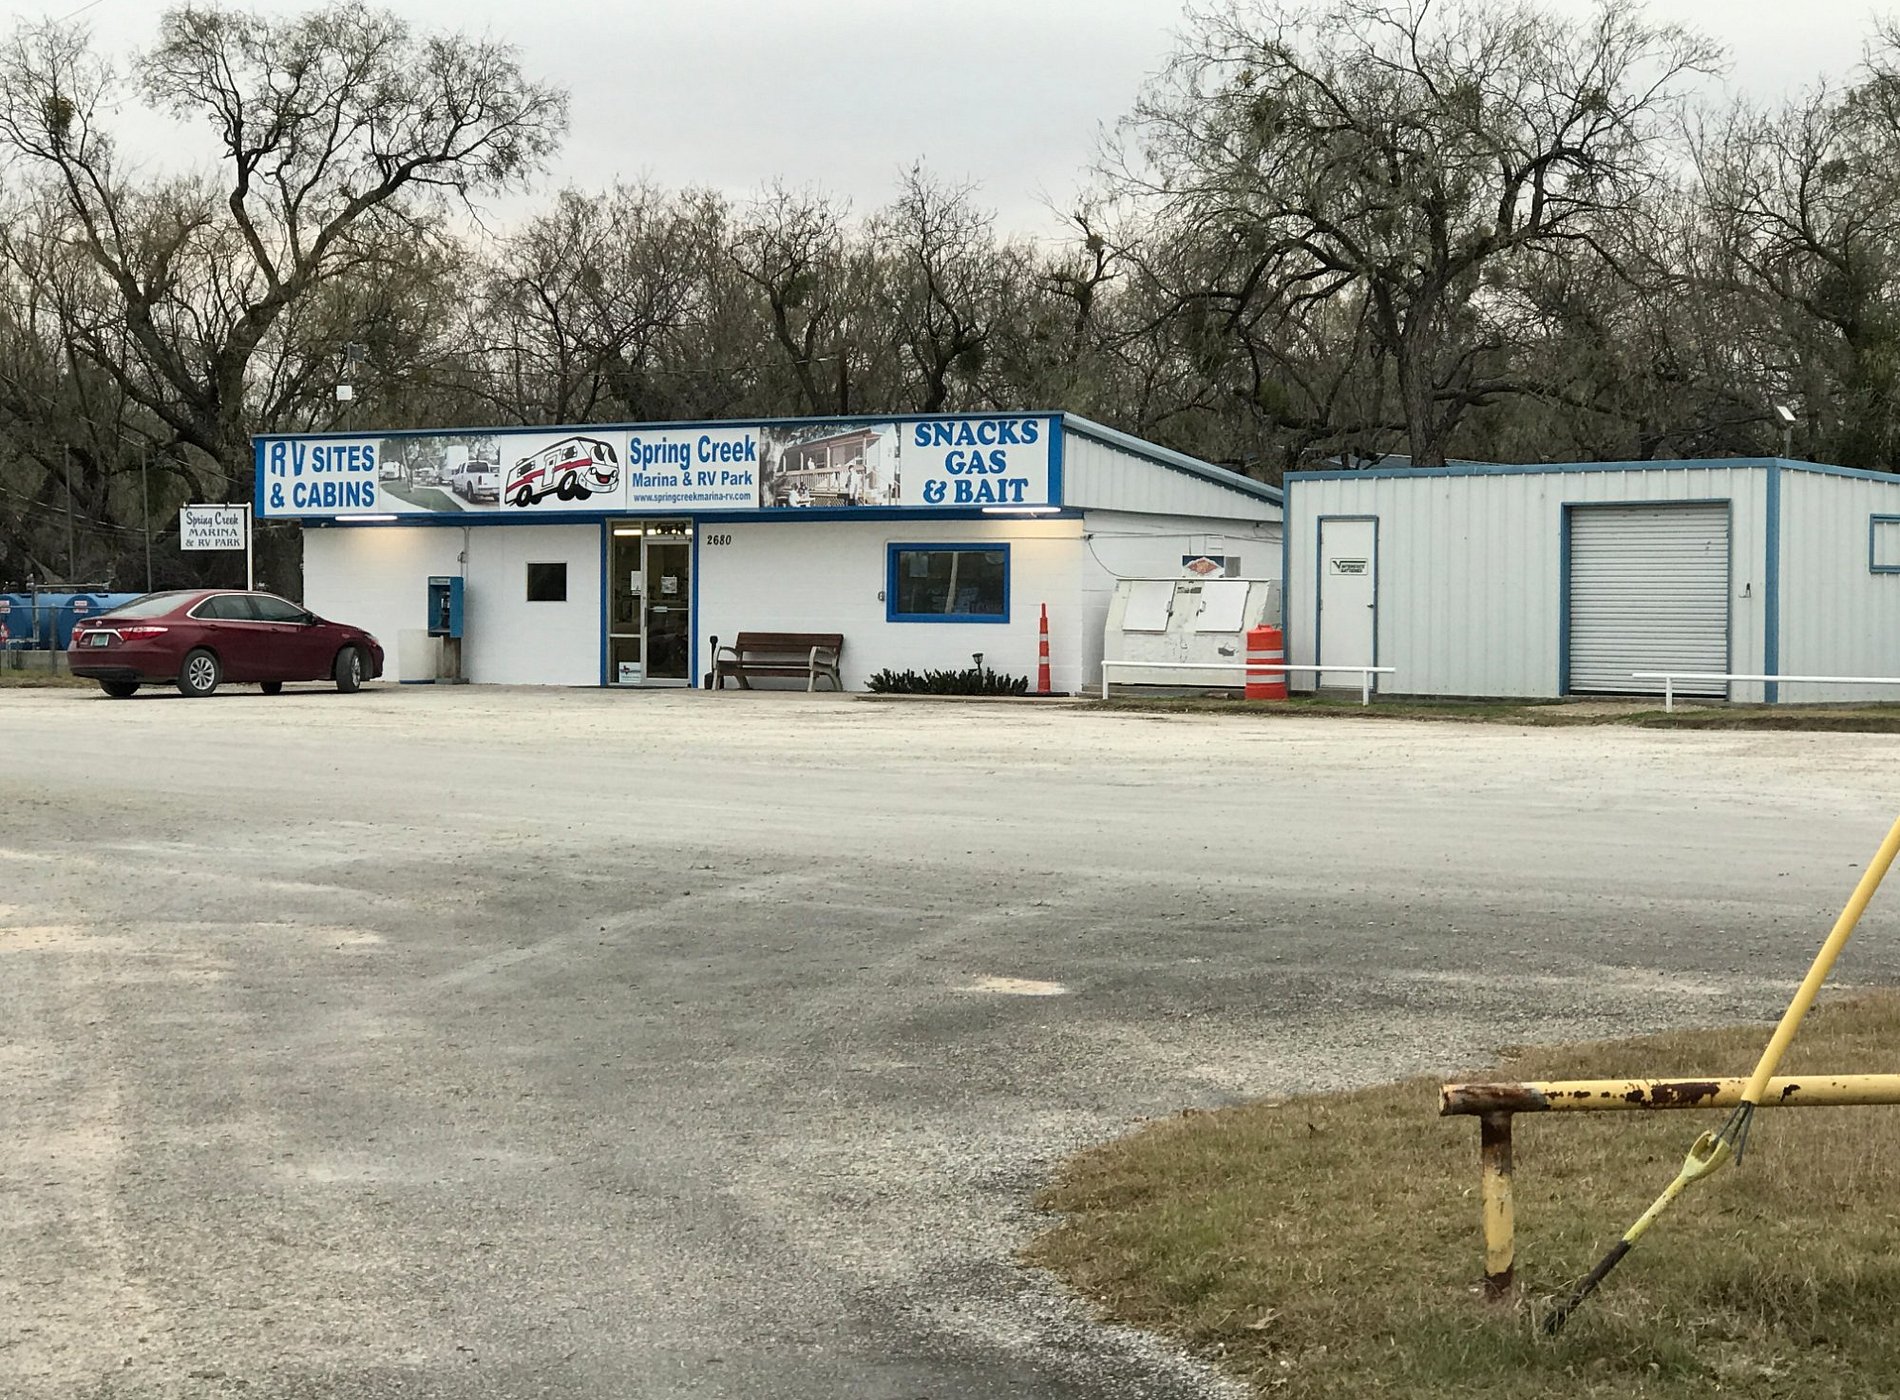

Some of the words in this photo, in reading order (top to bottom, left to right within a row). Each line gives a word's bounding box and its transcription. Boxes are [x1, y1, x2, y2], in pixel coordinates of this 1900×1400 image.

[914, 420, 1038, 446] SNACKS
[271, 441, 306, 477] RV
[312, 445, 374, 472] SITES
[630, 437, 691, 470] Spring
[698, 435, 756, 463] Creek
[945, 450, 1006, 474] GAS
[632, 473, 677, 487] Marina
[683, 472, 692, 486] &
[698, 471, 717, 486] RV
[721, 471, 752, 485] Park
[923, 480, 947, 504] &
[954, 478, 1028, 503] BAIT
[270, 482, 285, 508] &
[293, 481, 374, 508] CABINS
[634, 491, 751, 504] www.springcreekmarina-rv.com
[186, 511, 212, 527] Spring
[215, 512, 238, 525] Creek
[189, 528, 237, 536] MARINA
[707, 535, 732, 545] 2680
